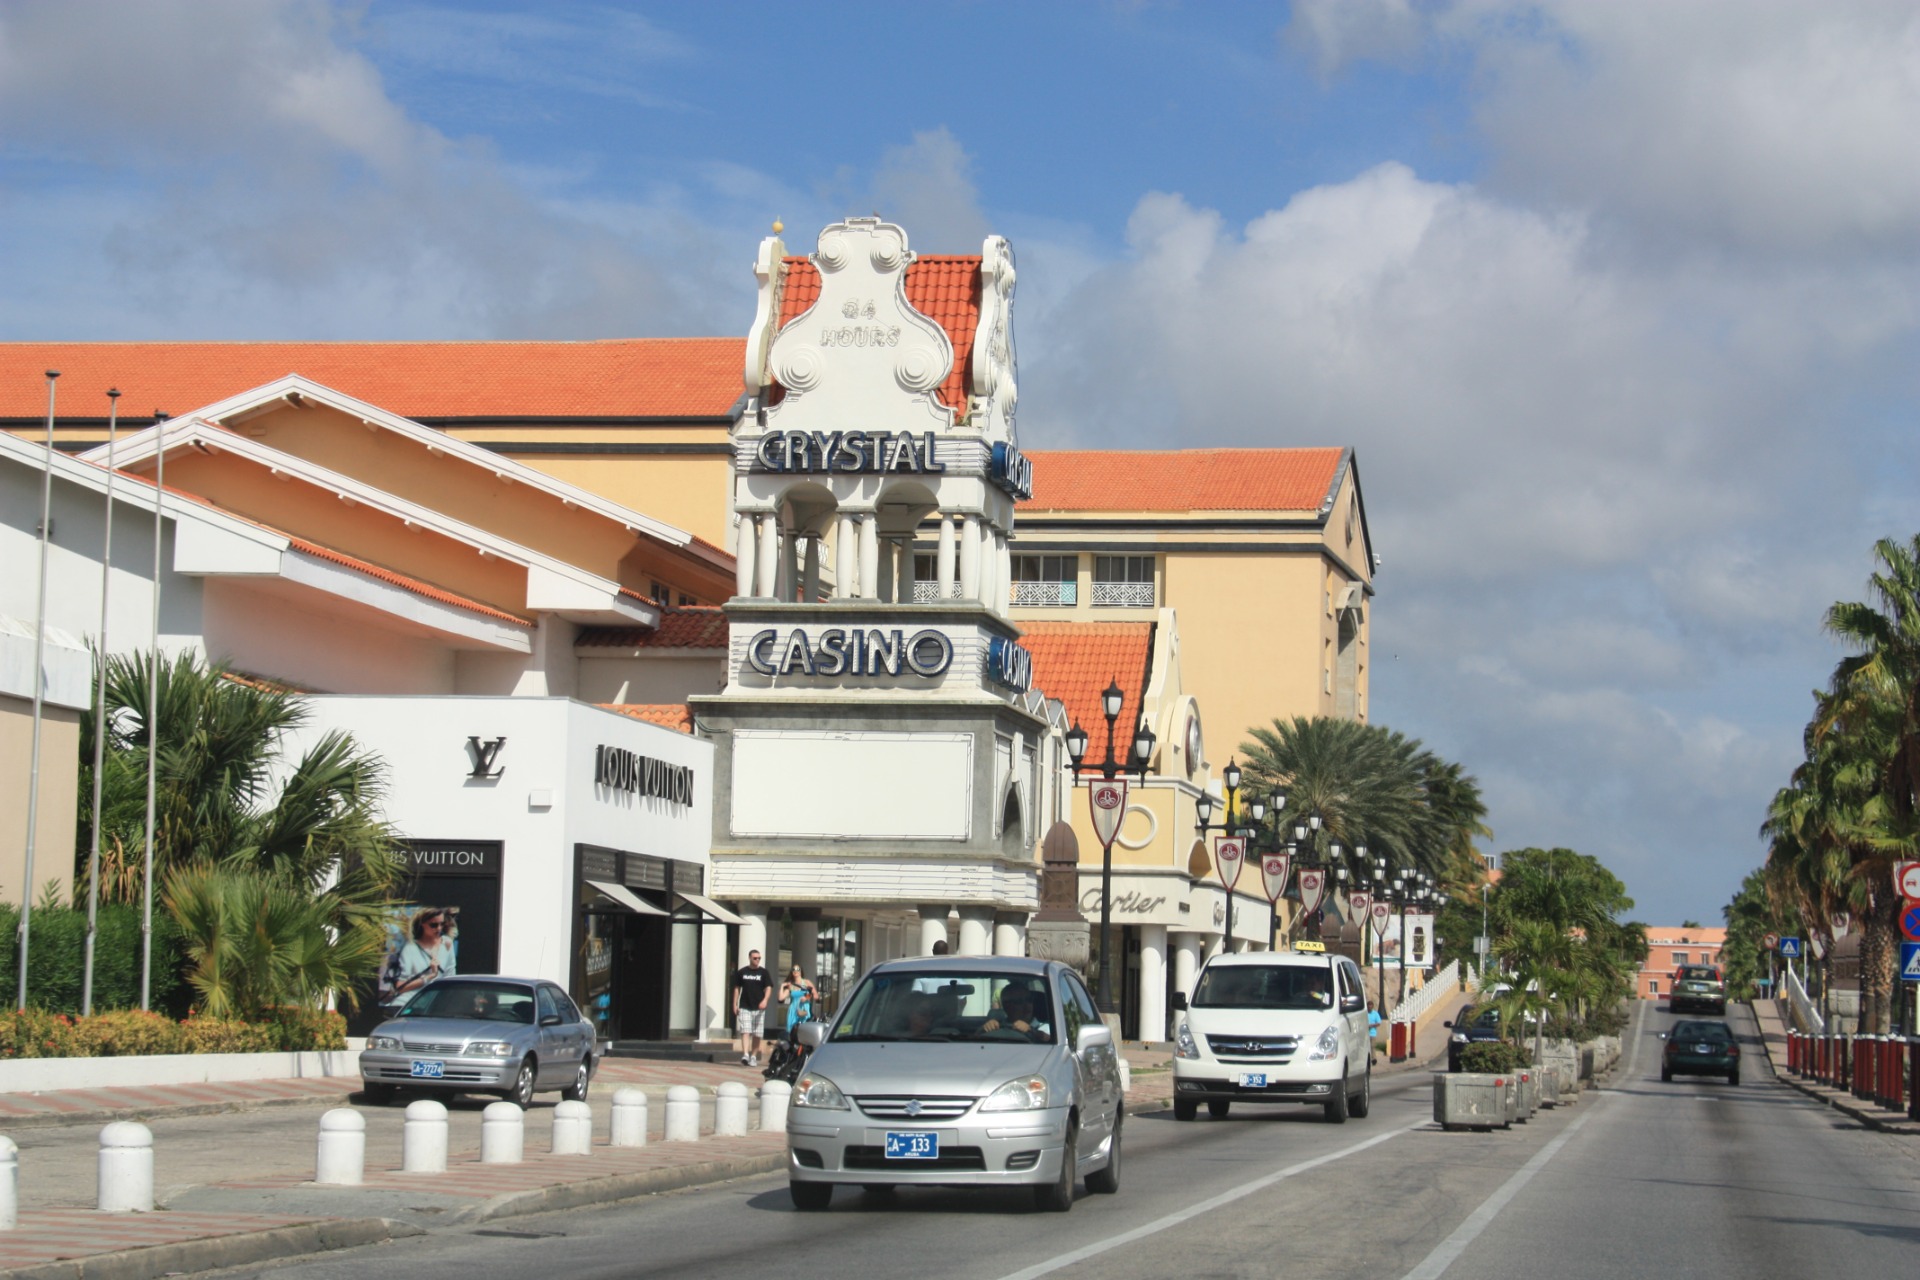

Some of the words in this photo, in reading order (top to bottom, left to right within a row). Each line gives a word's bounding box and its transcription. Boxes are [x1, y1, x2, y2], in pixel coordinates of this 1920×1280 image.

[820, 327, 901, 347] HOURS
[757, 430, 945, 473] CRYSTAL
[748, 628, 954, 678] CASINO
[1001, 638, 1033, 692] CASINO
[596, 744, 639, 794] LOUIS
[639, 755, 694, 808] VUITTON
[414, 851, 484, 865] VUITTON
[1079, 888, 1166, 915] Cartier
[911, 1138, 930, 1152] 133
